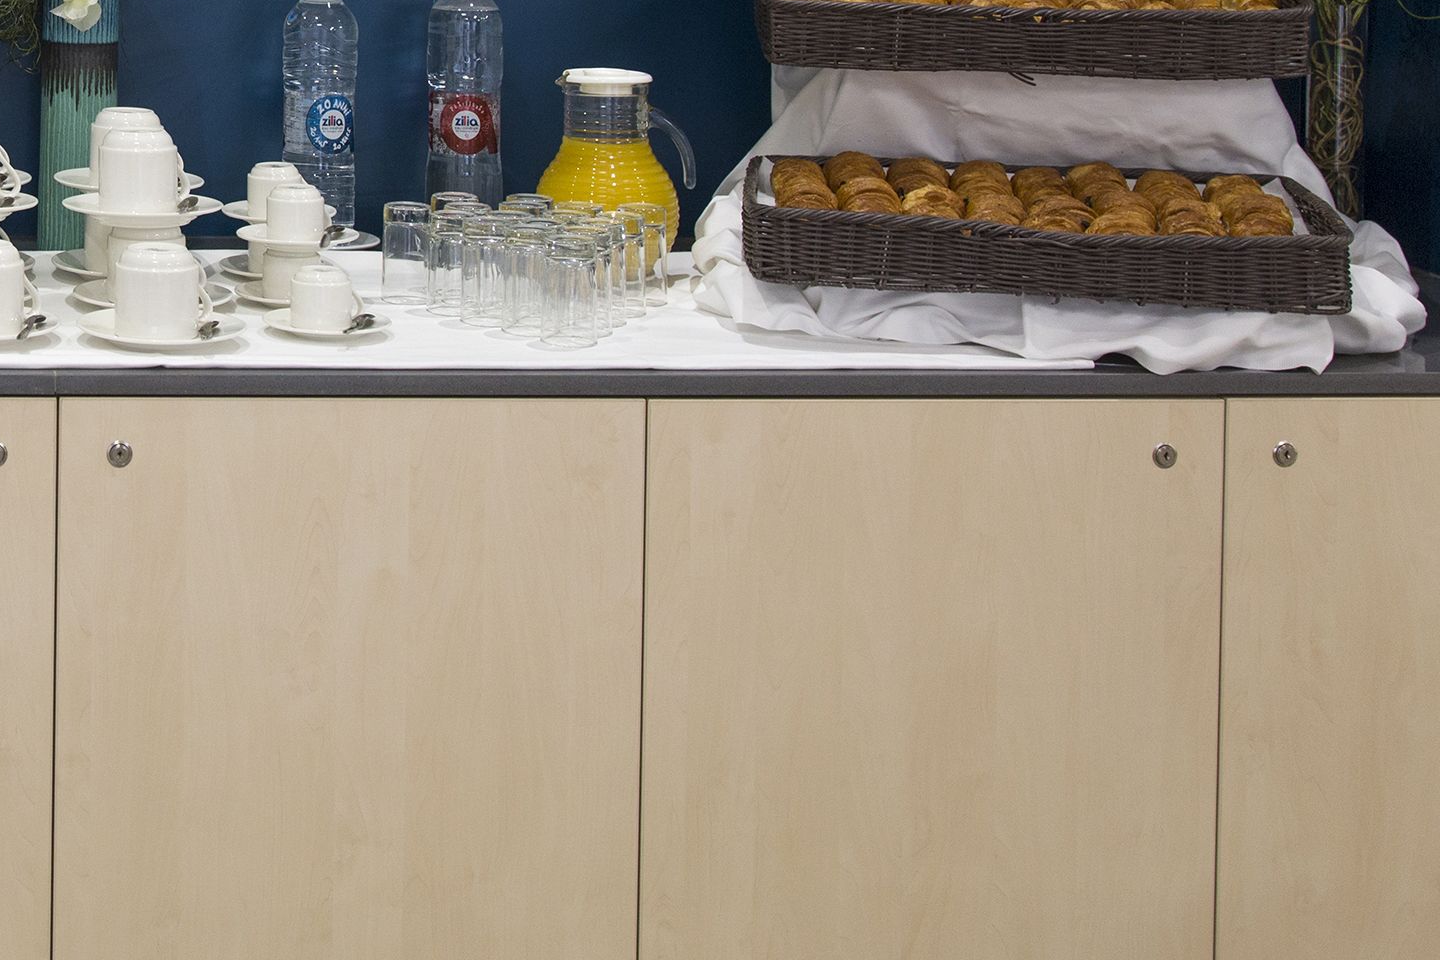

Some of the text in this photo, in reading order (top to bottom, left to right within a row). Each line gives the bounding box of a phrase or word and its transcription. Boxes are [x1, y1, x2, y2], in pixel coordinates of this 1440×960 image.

[316, 99, 331, 115] 20
[322, 115, 344, 126] zilia
[455, 115, 479, 127] zilia
